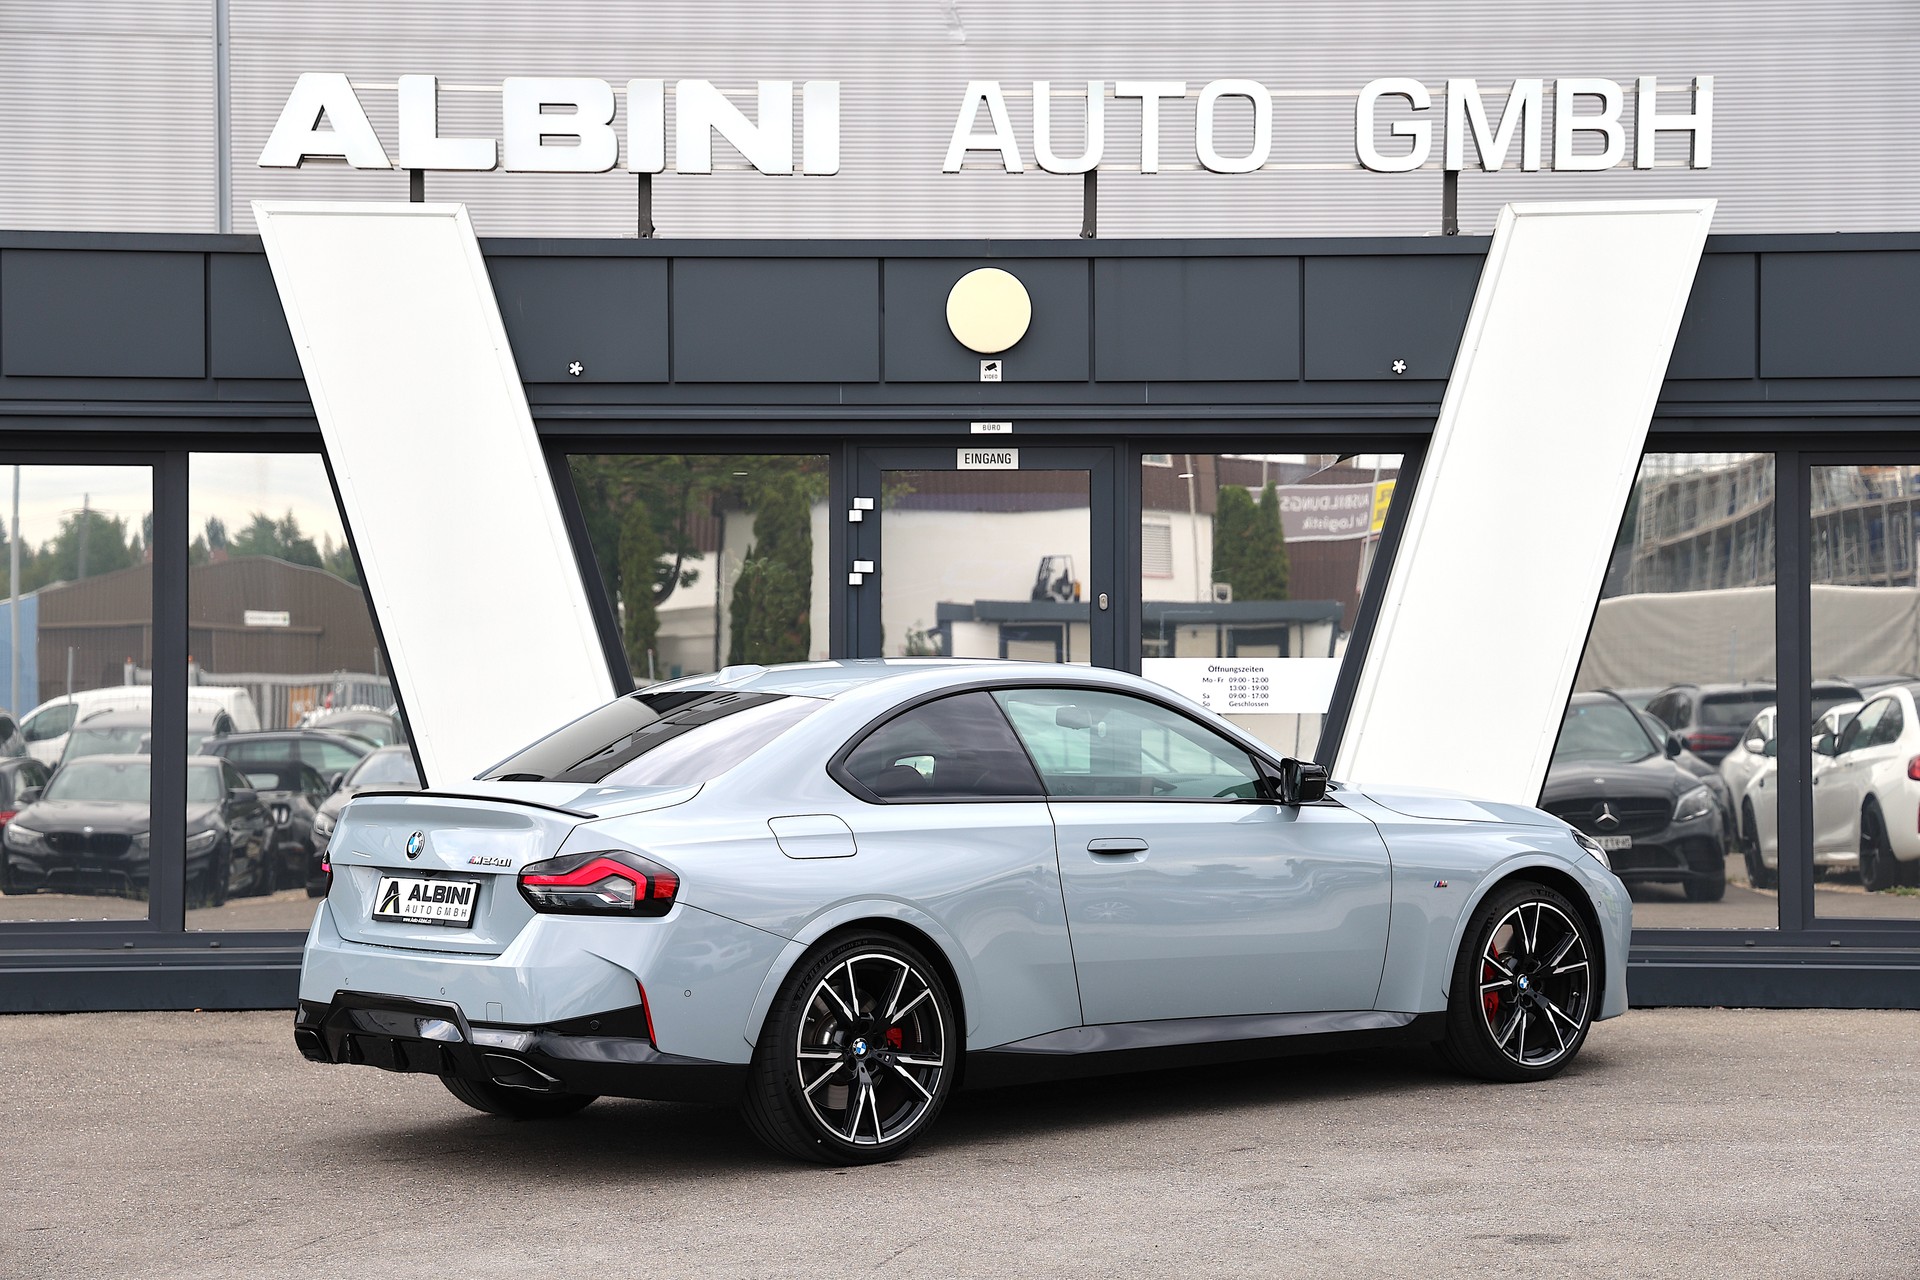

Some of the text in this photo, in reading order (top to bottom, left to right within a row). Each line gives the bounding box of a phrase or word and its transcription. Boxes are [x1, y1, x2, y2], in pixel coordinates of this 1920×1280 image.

[257, 72, 1714, 176] ALBINI AUTO GMBH
[982, 423, 1001, 431] BÜRO
[964, 453, 1012, 465] EINGANG
[1208, 665, 1264, 674] Öffnungszeiten
[407, 884, 471, 905] ALBINI
[404, 904, 468, 918] AUTO GMBH
